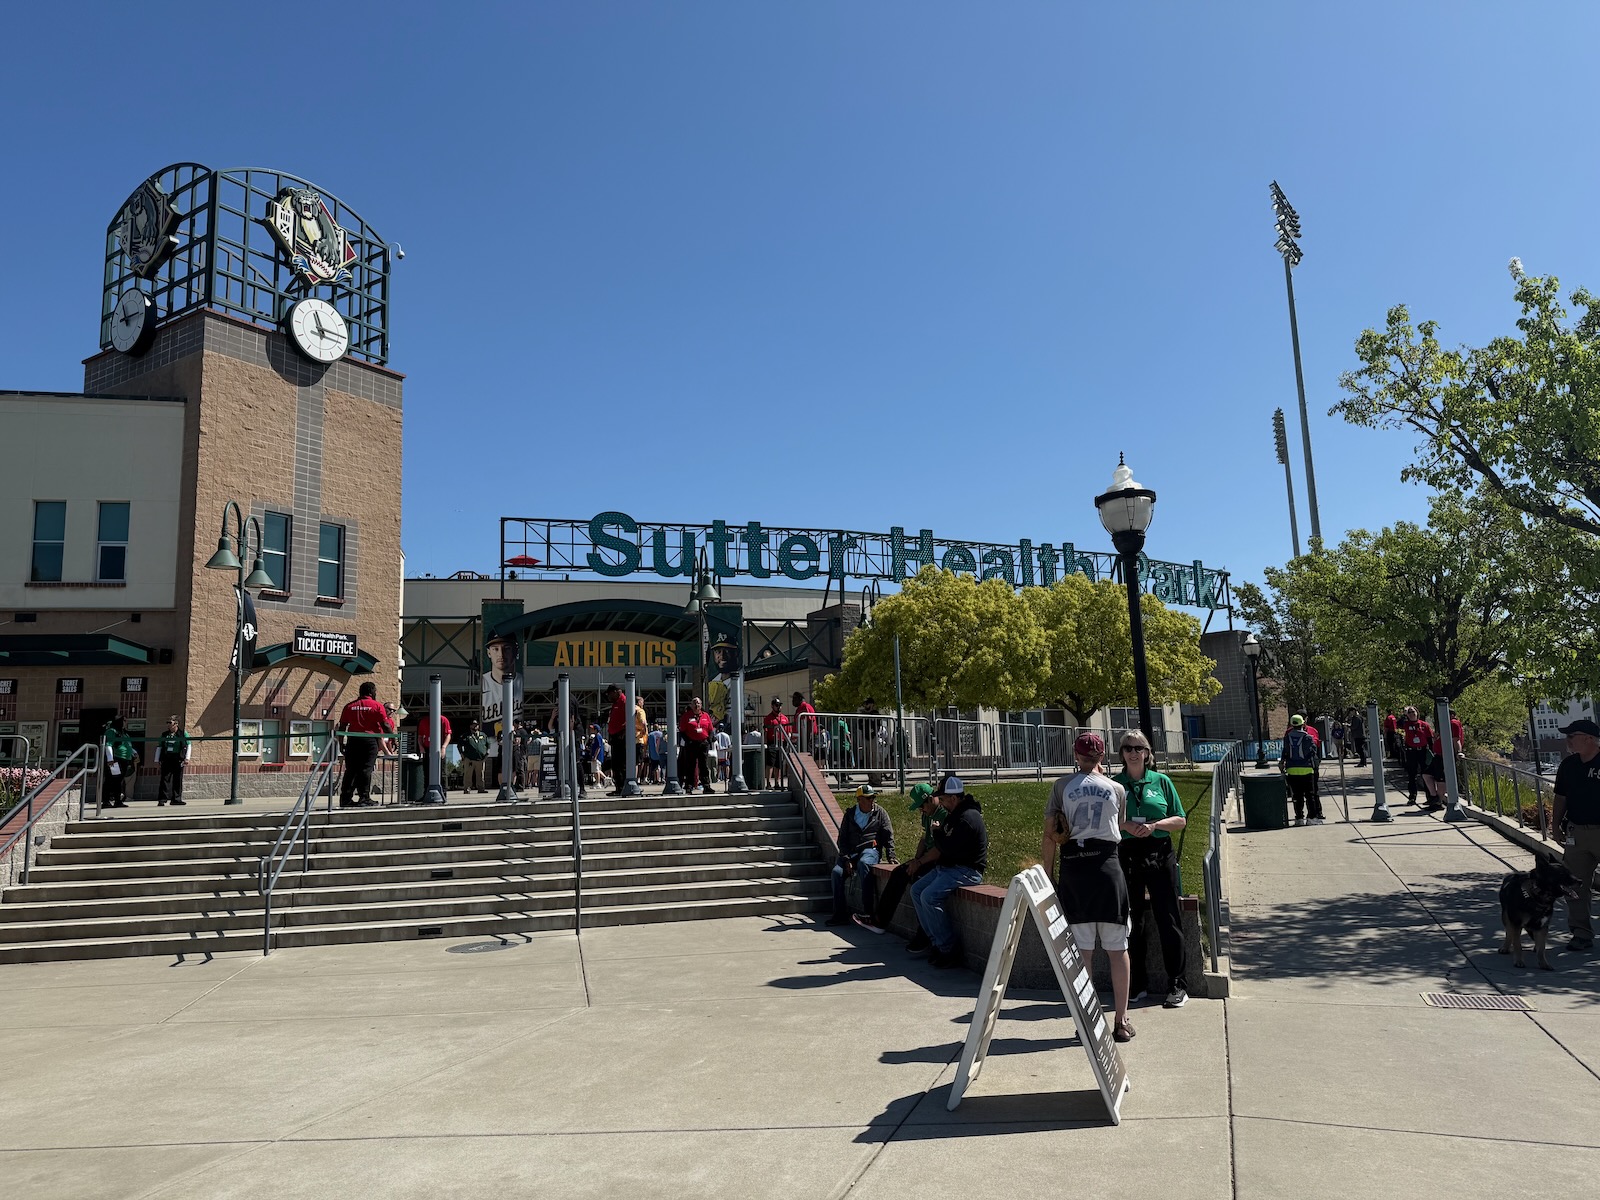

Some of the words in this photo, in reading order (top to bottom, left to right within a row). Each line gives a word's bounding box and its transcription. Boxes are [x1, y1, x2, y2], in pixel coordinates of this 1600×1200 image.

[586, 511, 857, 580] Sutter
[890, 526, 1095, 588] Health
[297, 636, 326, 652] TICKET
[326, 639, 354, 655] OFFICE
[303, 630, 319, 638] Sutter
[554, 640, 677, 667] ATHLETICS
[1068, 785, 1112, 802] SEAVER
[1071, 801, 1104, 830] 41
